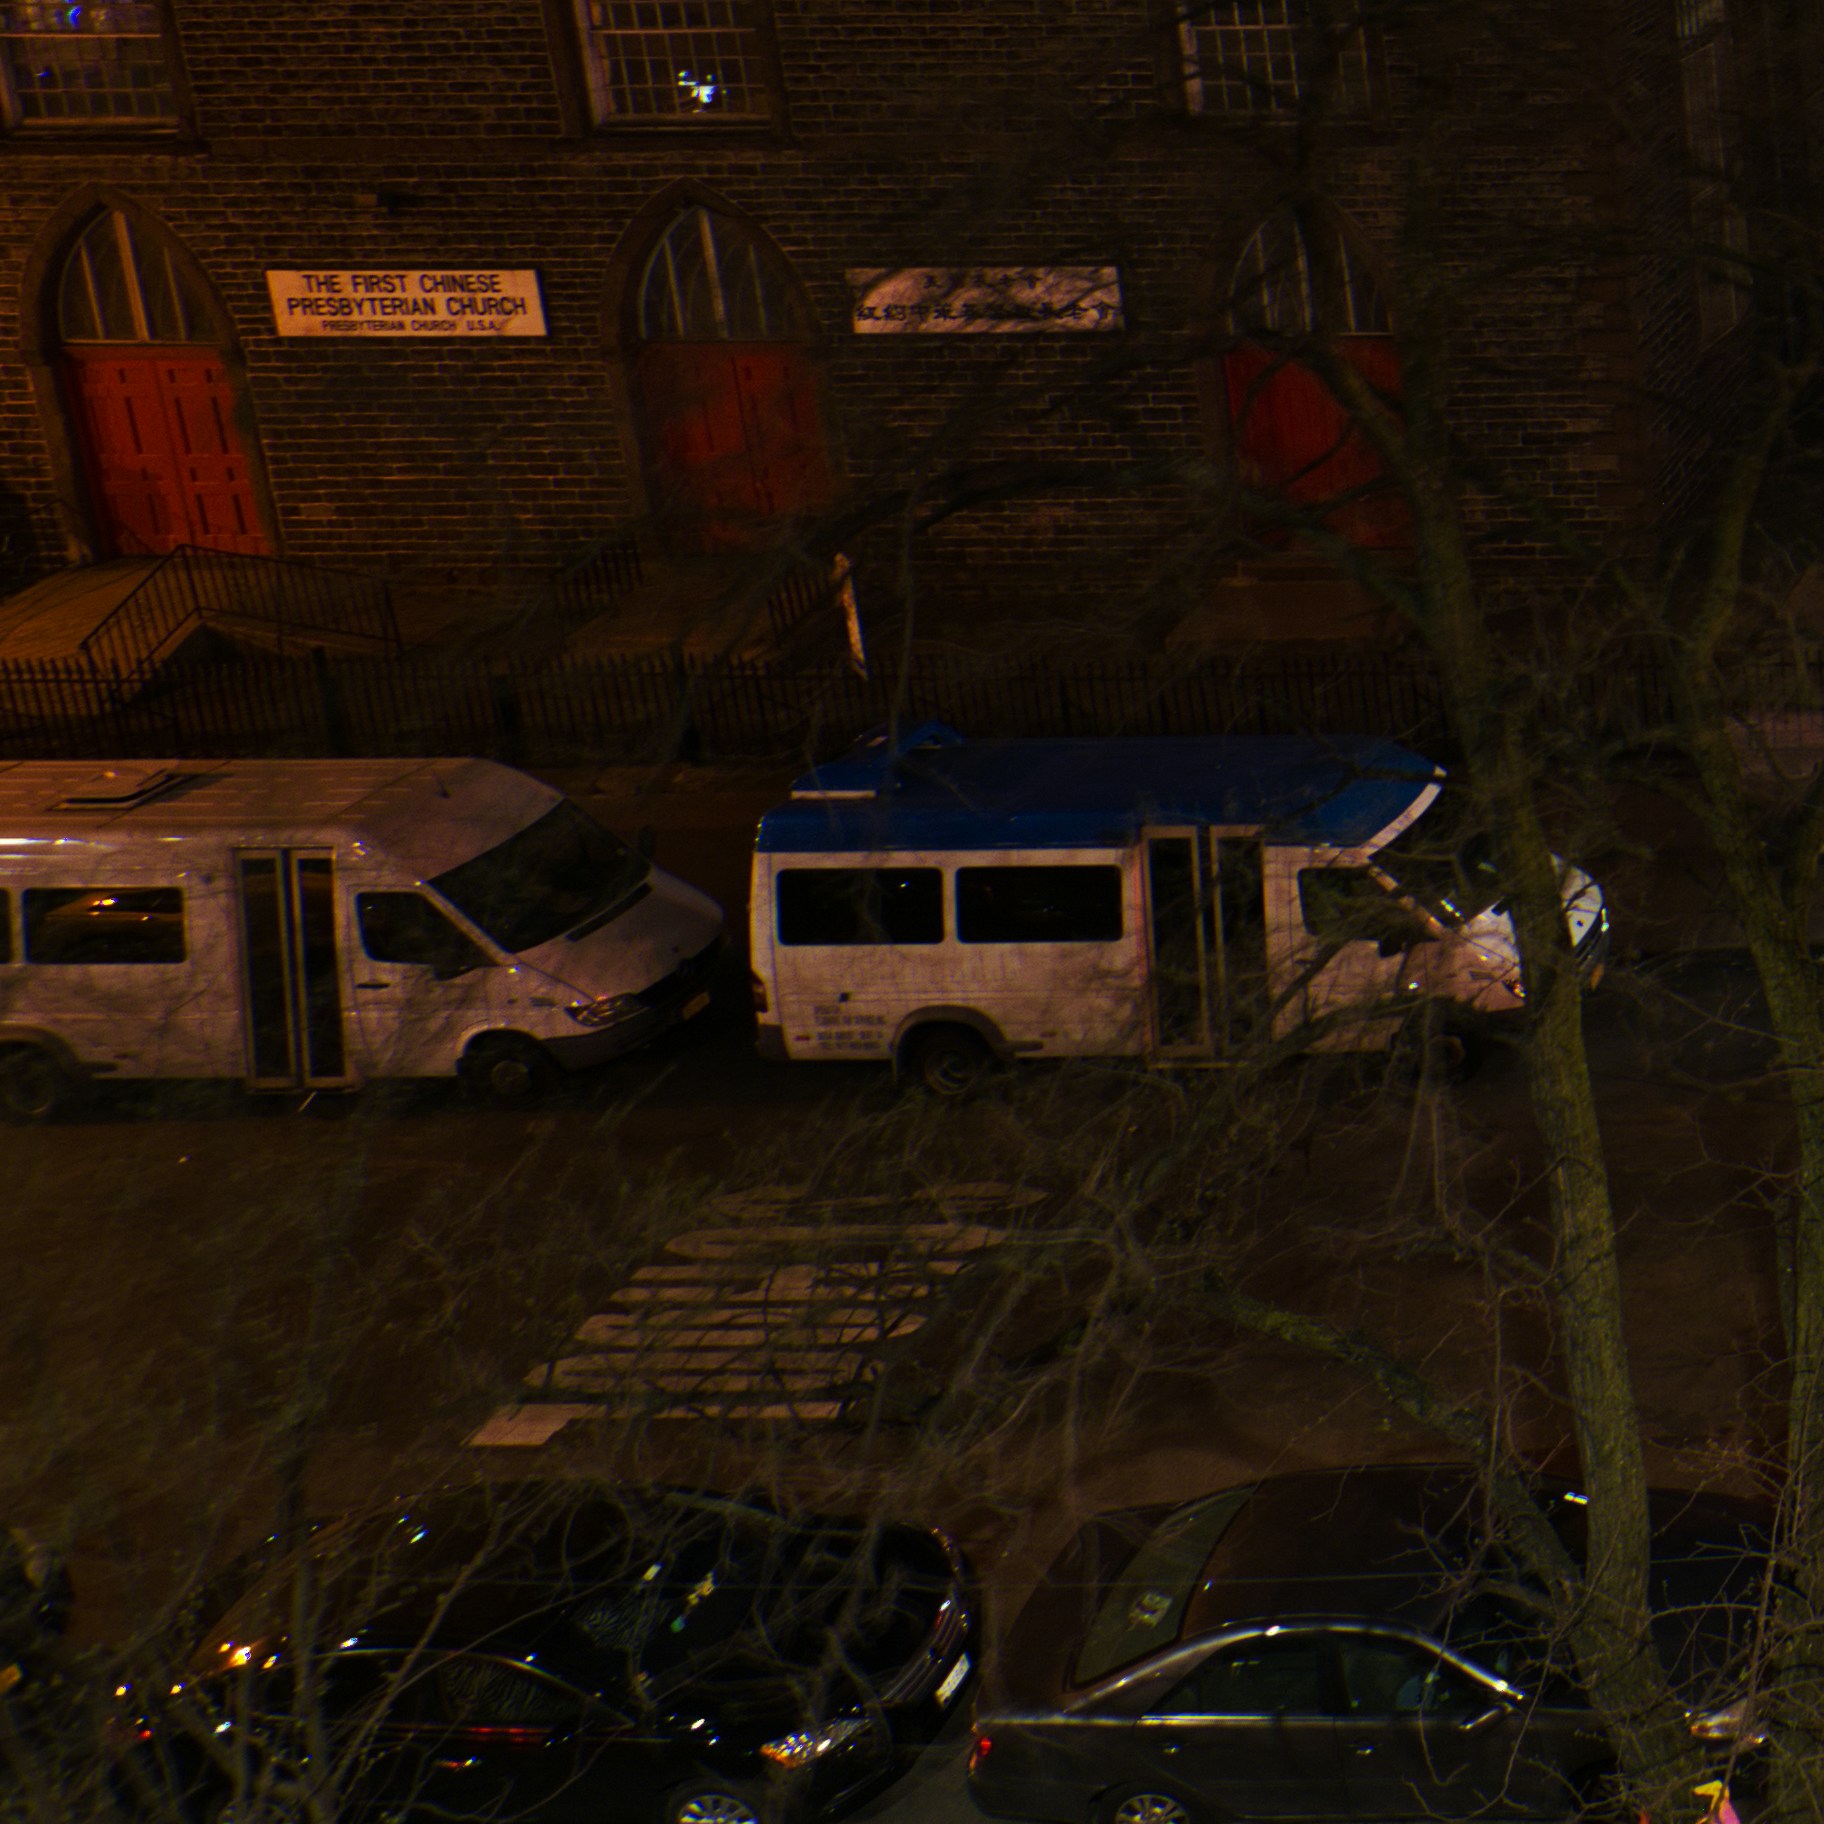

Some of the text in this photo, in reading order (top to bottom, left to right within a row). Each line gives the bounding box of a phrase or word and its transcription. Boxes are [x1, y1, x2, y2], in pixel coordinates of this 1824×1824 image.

[302, 274, 502, 293] THE FIRST CHINESE
[287, 297, 528, 315] PRESBYTERIAN CHURCH
[321, 320, 405, 331] PRESBYTERIAN
[411, 320, 459, 331] CHURCH
